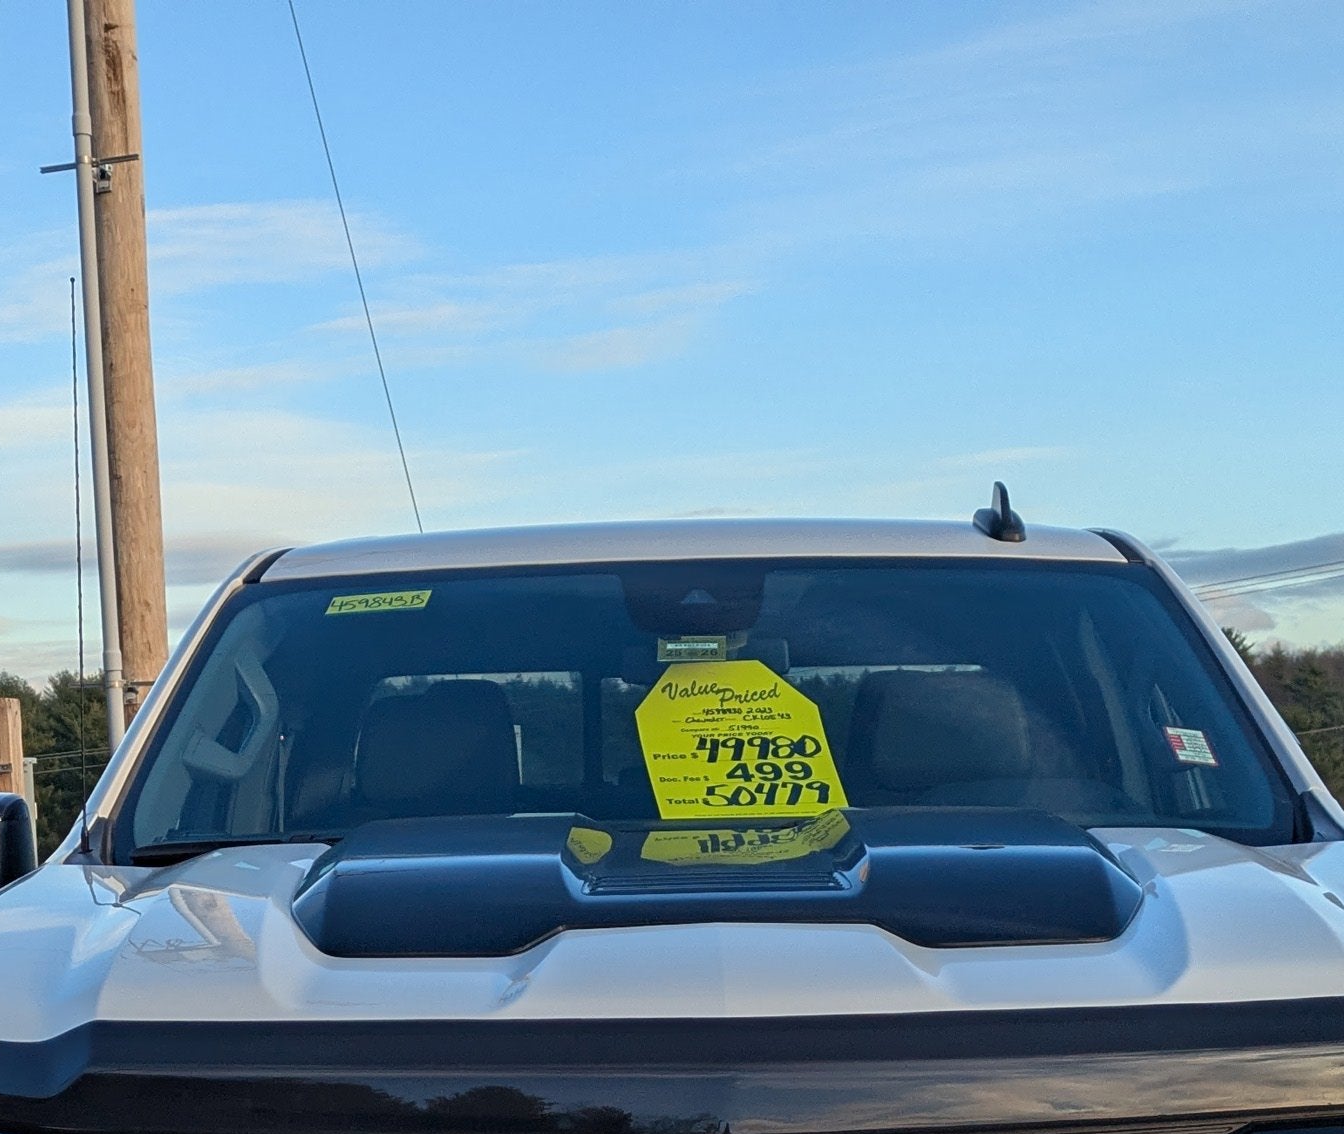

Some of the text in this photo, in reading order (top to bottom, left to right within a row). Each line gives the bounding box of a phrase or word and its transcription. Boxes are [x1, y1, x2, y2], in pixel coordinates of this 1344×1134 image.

[661, 680, 781, 708] Value Priced
[690, 752, 699, 760] $
[696, 735, 823, 763] 49980
[726, 760, 813, 782] 499
[705, 780, 831, 807] 50479
